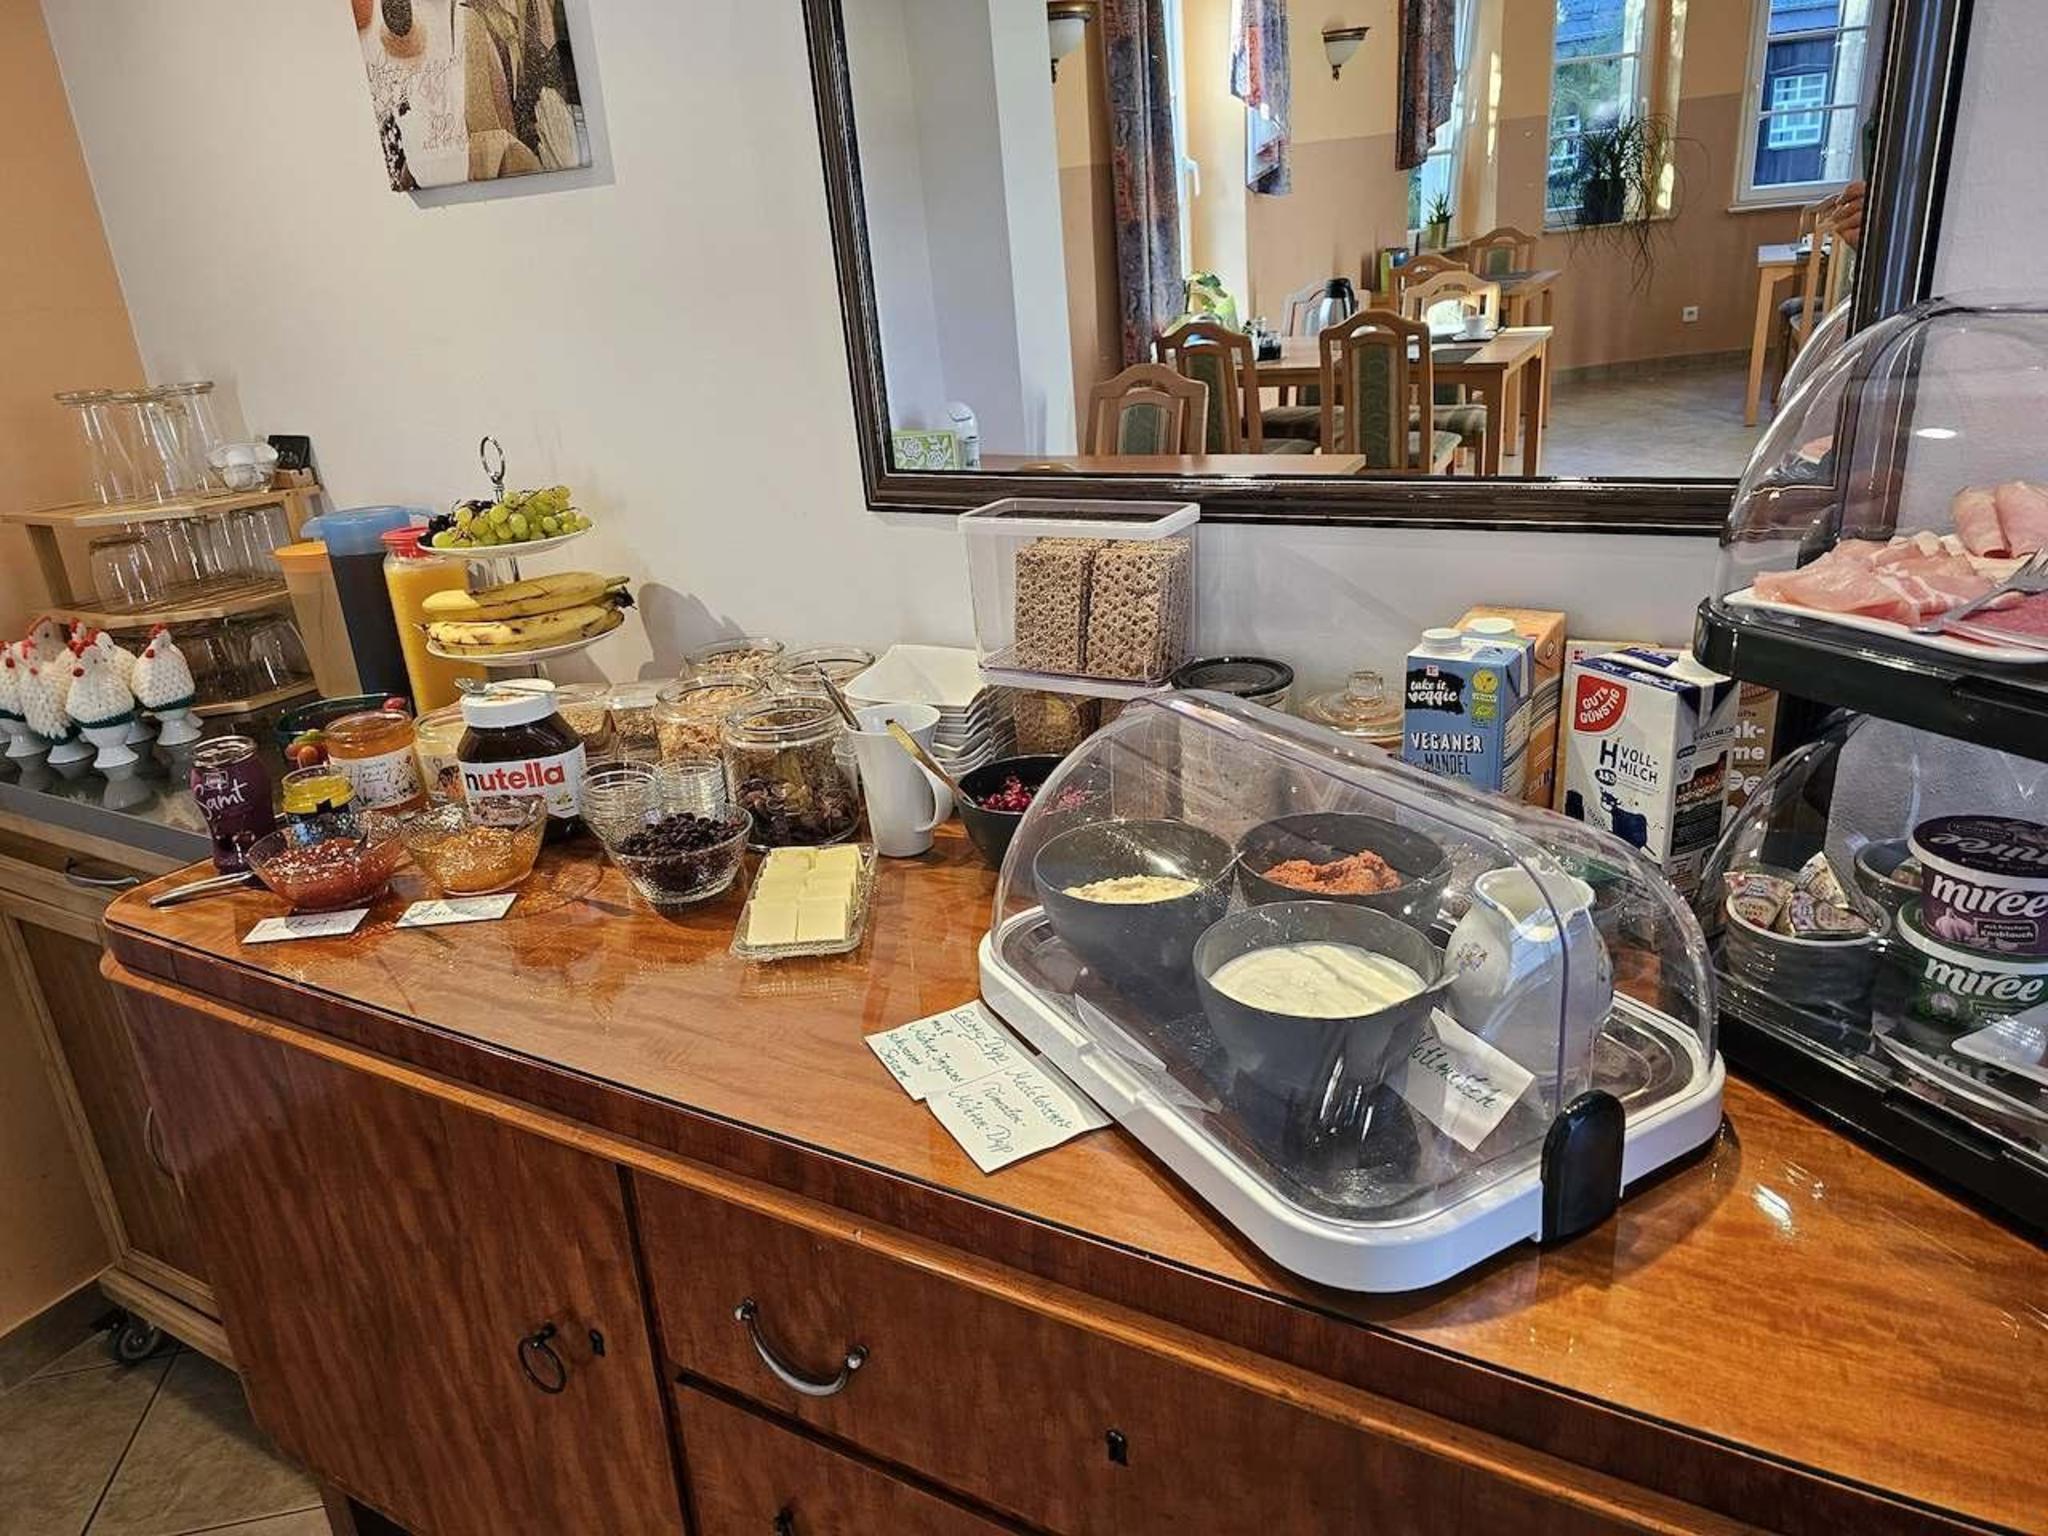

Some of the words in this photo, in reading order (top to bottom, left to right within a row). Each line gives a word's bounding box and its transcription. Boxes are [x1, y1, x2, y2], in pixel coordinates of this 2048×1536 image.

[1408, 690, 1458, 706] veggie
[1411, 679, 1435, 691] take
[1411, 733, 1483, 753] VEGANER
[1600, 739, 1618, 769] H
[1621, 746, 1659, 768] VOLL-
[465, 762, 565, 792] nutella
[1424, 753, 1471, 775] MANDEL
[1619, 759, 1658, 785] MILCH
[194, 778, 248, 820] Samt
[1931, 874, 2048, 918] miree
[1980, 930, 2034, 939] Knoblauch
[1923, 957, 2044, 1003] miree
